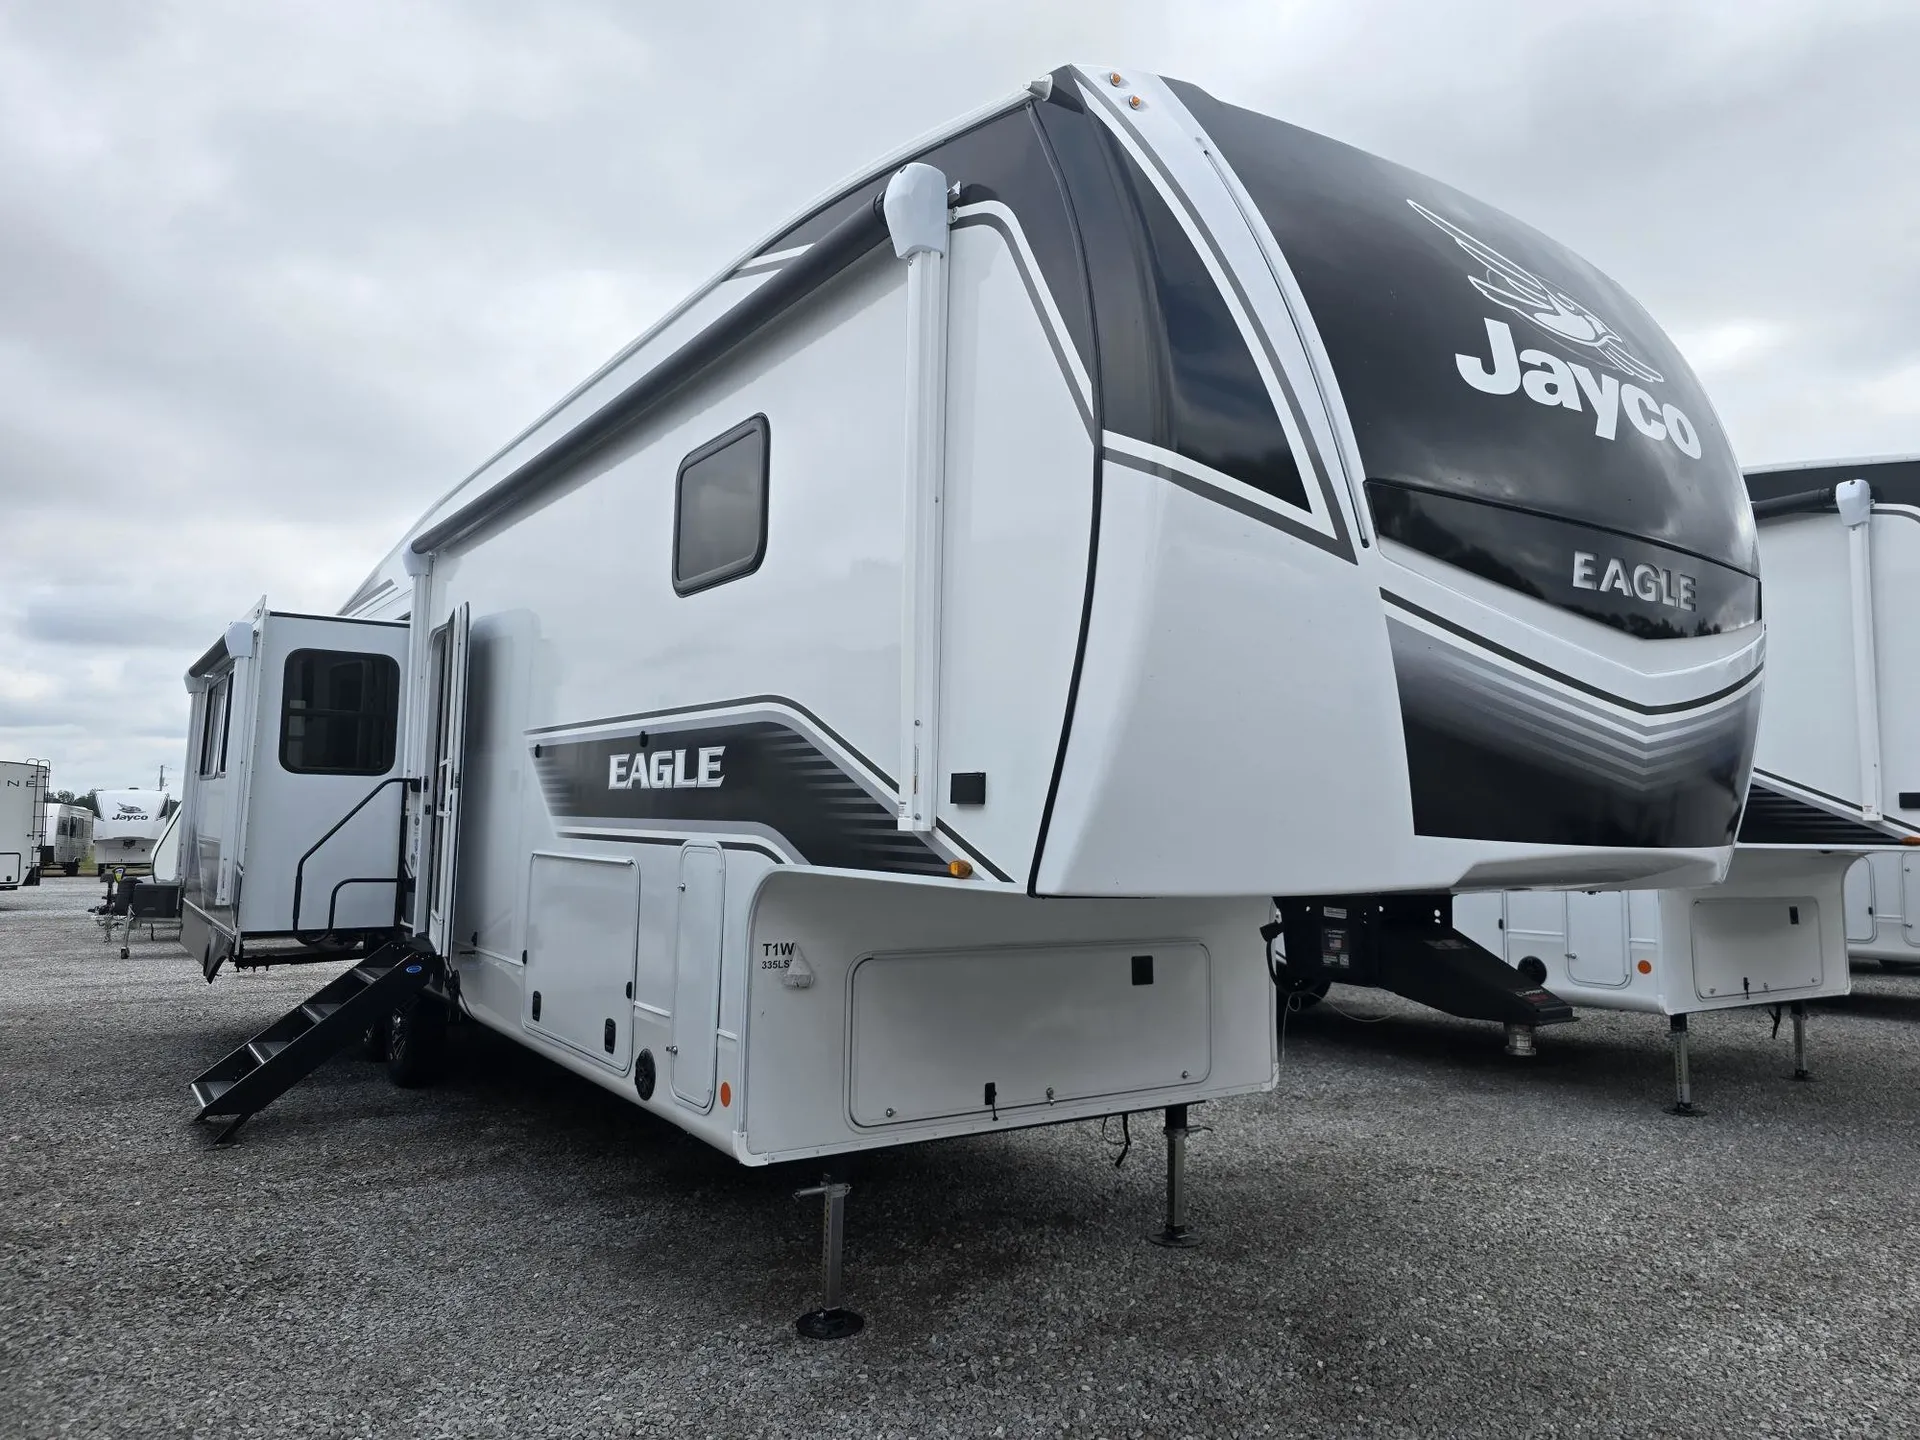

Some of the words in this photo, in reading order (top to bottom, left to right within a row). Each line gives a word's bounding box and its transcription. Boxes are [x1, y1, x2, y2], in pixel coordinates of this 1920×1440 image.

[1455, 317, 1702, 460] Jayco
[1572, 550, 1697, 613] EAGLE
[608, 745, 727, 790] EAGLE
[111, 813, 149, 822] Jayco
[761, 959, 793, 970] 335LS
[762, 942, 795, 957] T1W
